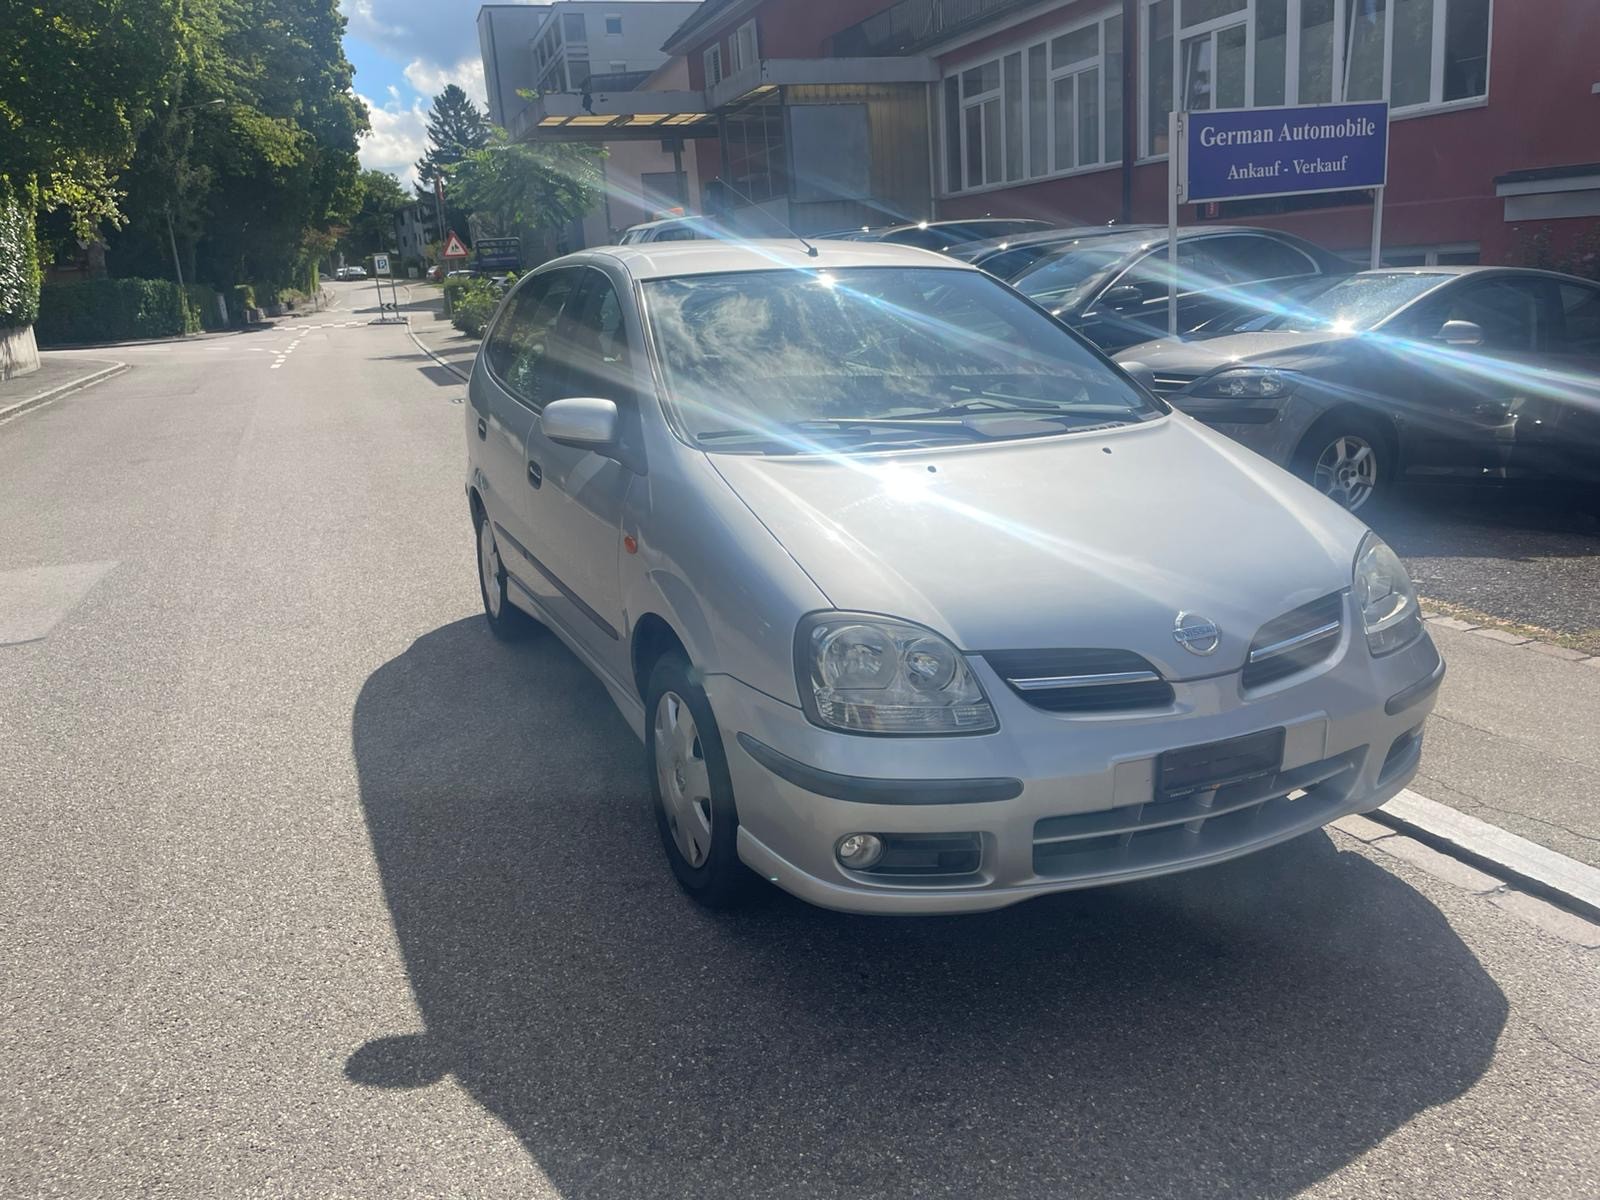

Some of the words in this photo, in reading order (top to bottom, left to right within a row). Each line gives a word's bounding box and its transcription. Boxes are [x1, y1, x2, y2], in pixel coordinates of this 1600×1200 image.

[1200, 127, 1273, 147] German
[1278, 118, 1376, 142] Automobile
[1227, 161, 1281, 180] Ankauf
[1293, 155, 1348, 174] Verkauf
